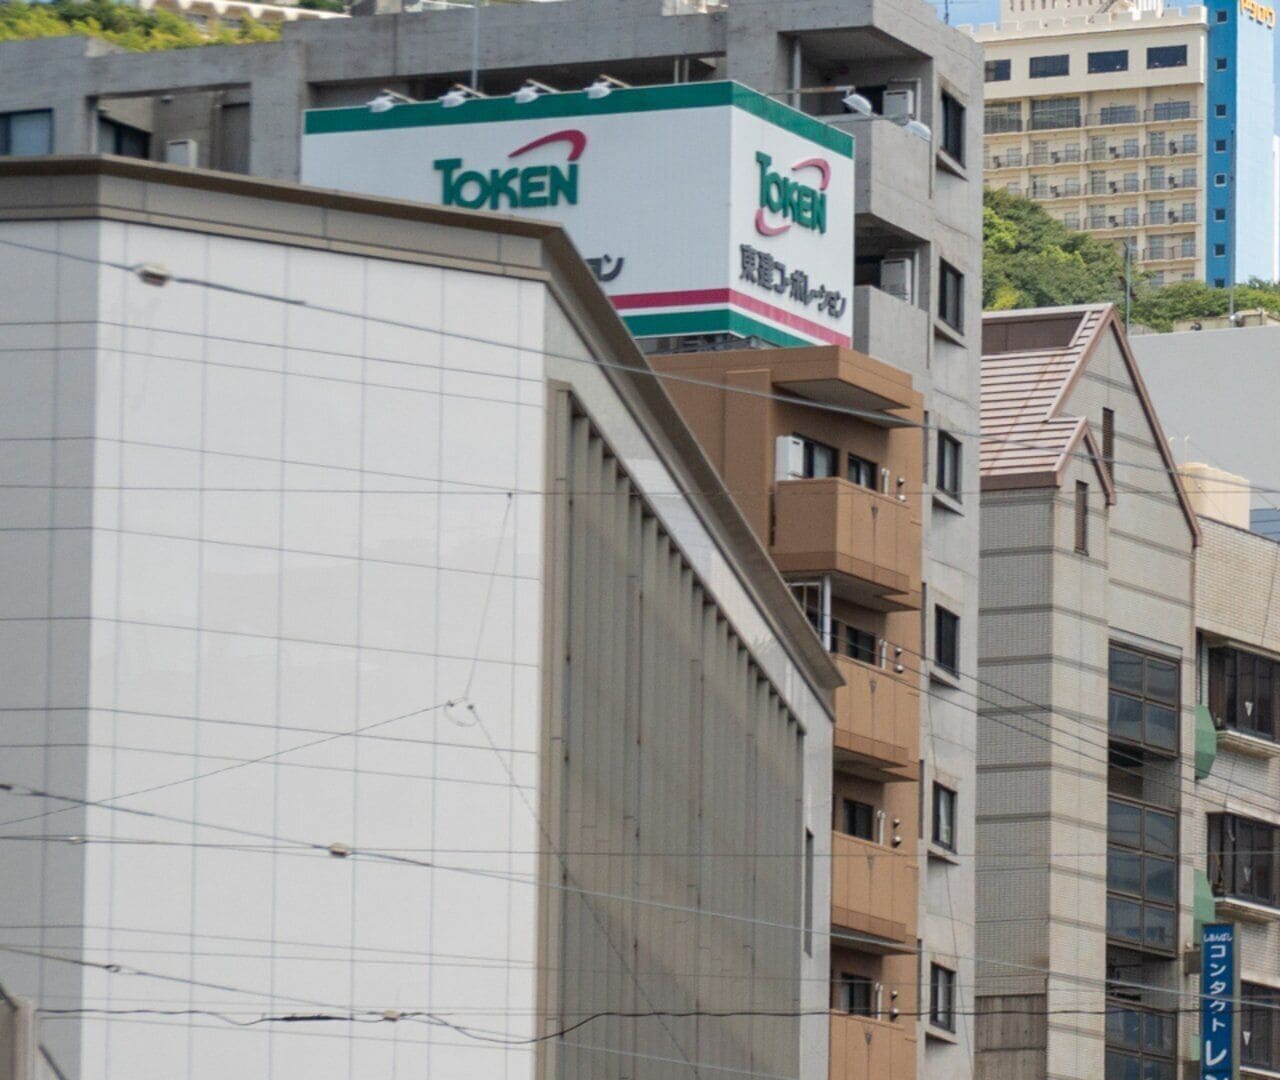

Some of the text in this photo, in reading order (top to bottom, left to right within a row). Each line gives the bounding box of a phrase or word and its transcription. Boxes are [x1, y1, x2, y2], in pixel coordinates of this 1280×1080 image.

[433, 157, 580, 211] TOKEN
[755, 149, 827, 235] TOKEN
[738, 242, 848, 320] 東建コーポレーション
